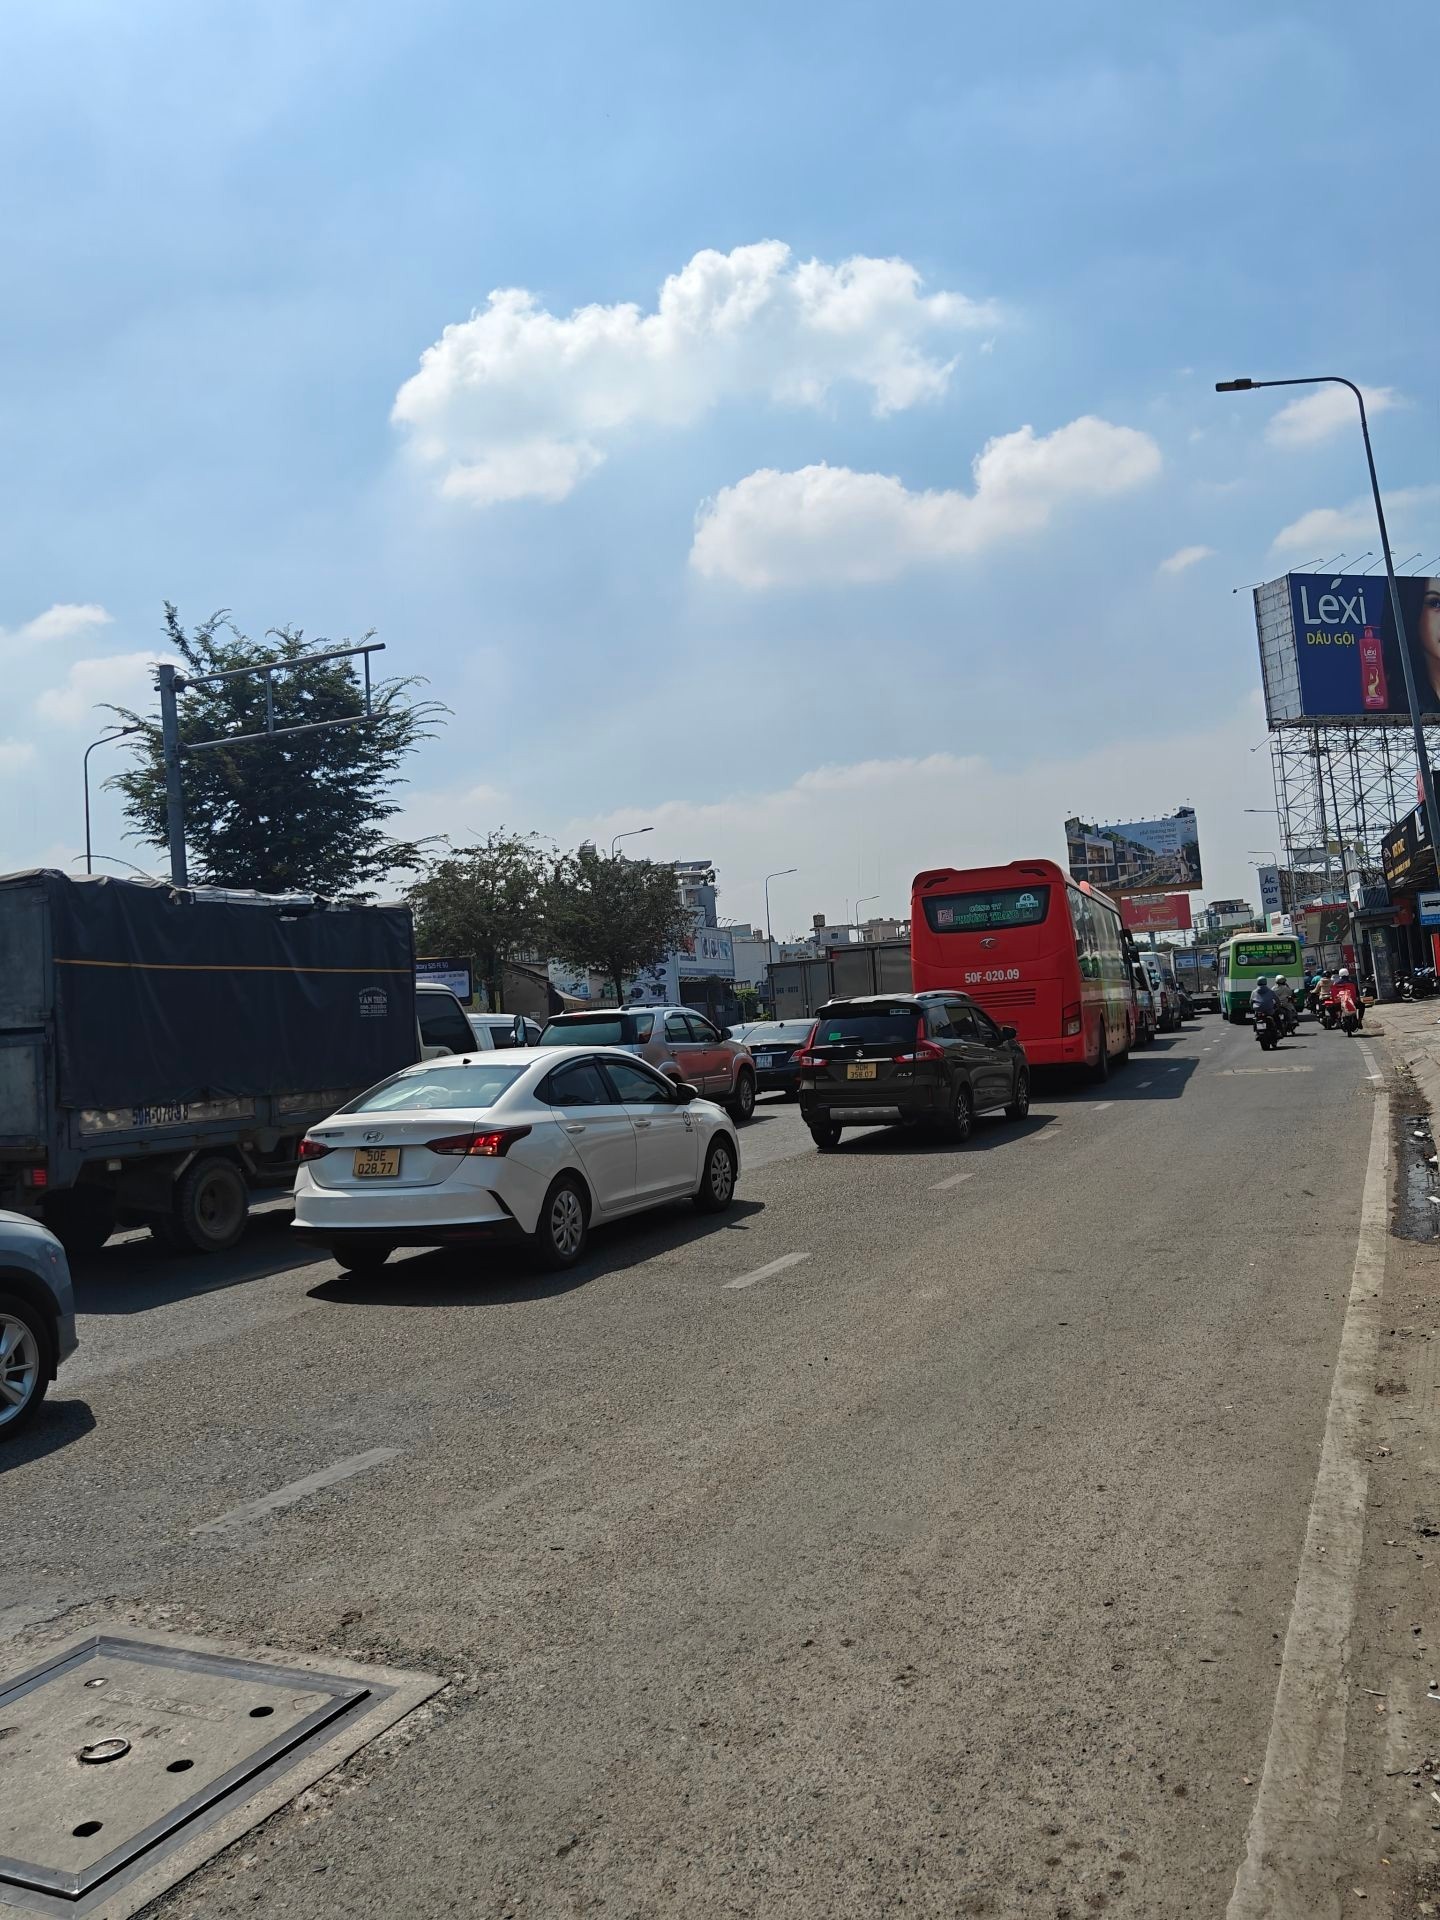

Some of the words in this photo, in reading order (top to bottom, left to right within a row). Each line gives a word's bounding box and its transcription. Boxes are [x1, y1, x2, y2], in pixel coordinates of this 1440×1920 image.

[1265, 897, 1278, 905] GS
[964, 968, 1020, 984] 50F-020.09
[367, 1150, 387, 1162] 50E
[357, 1162, 394, 1175] 028.77
